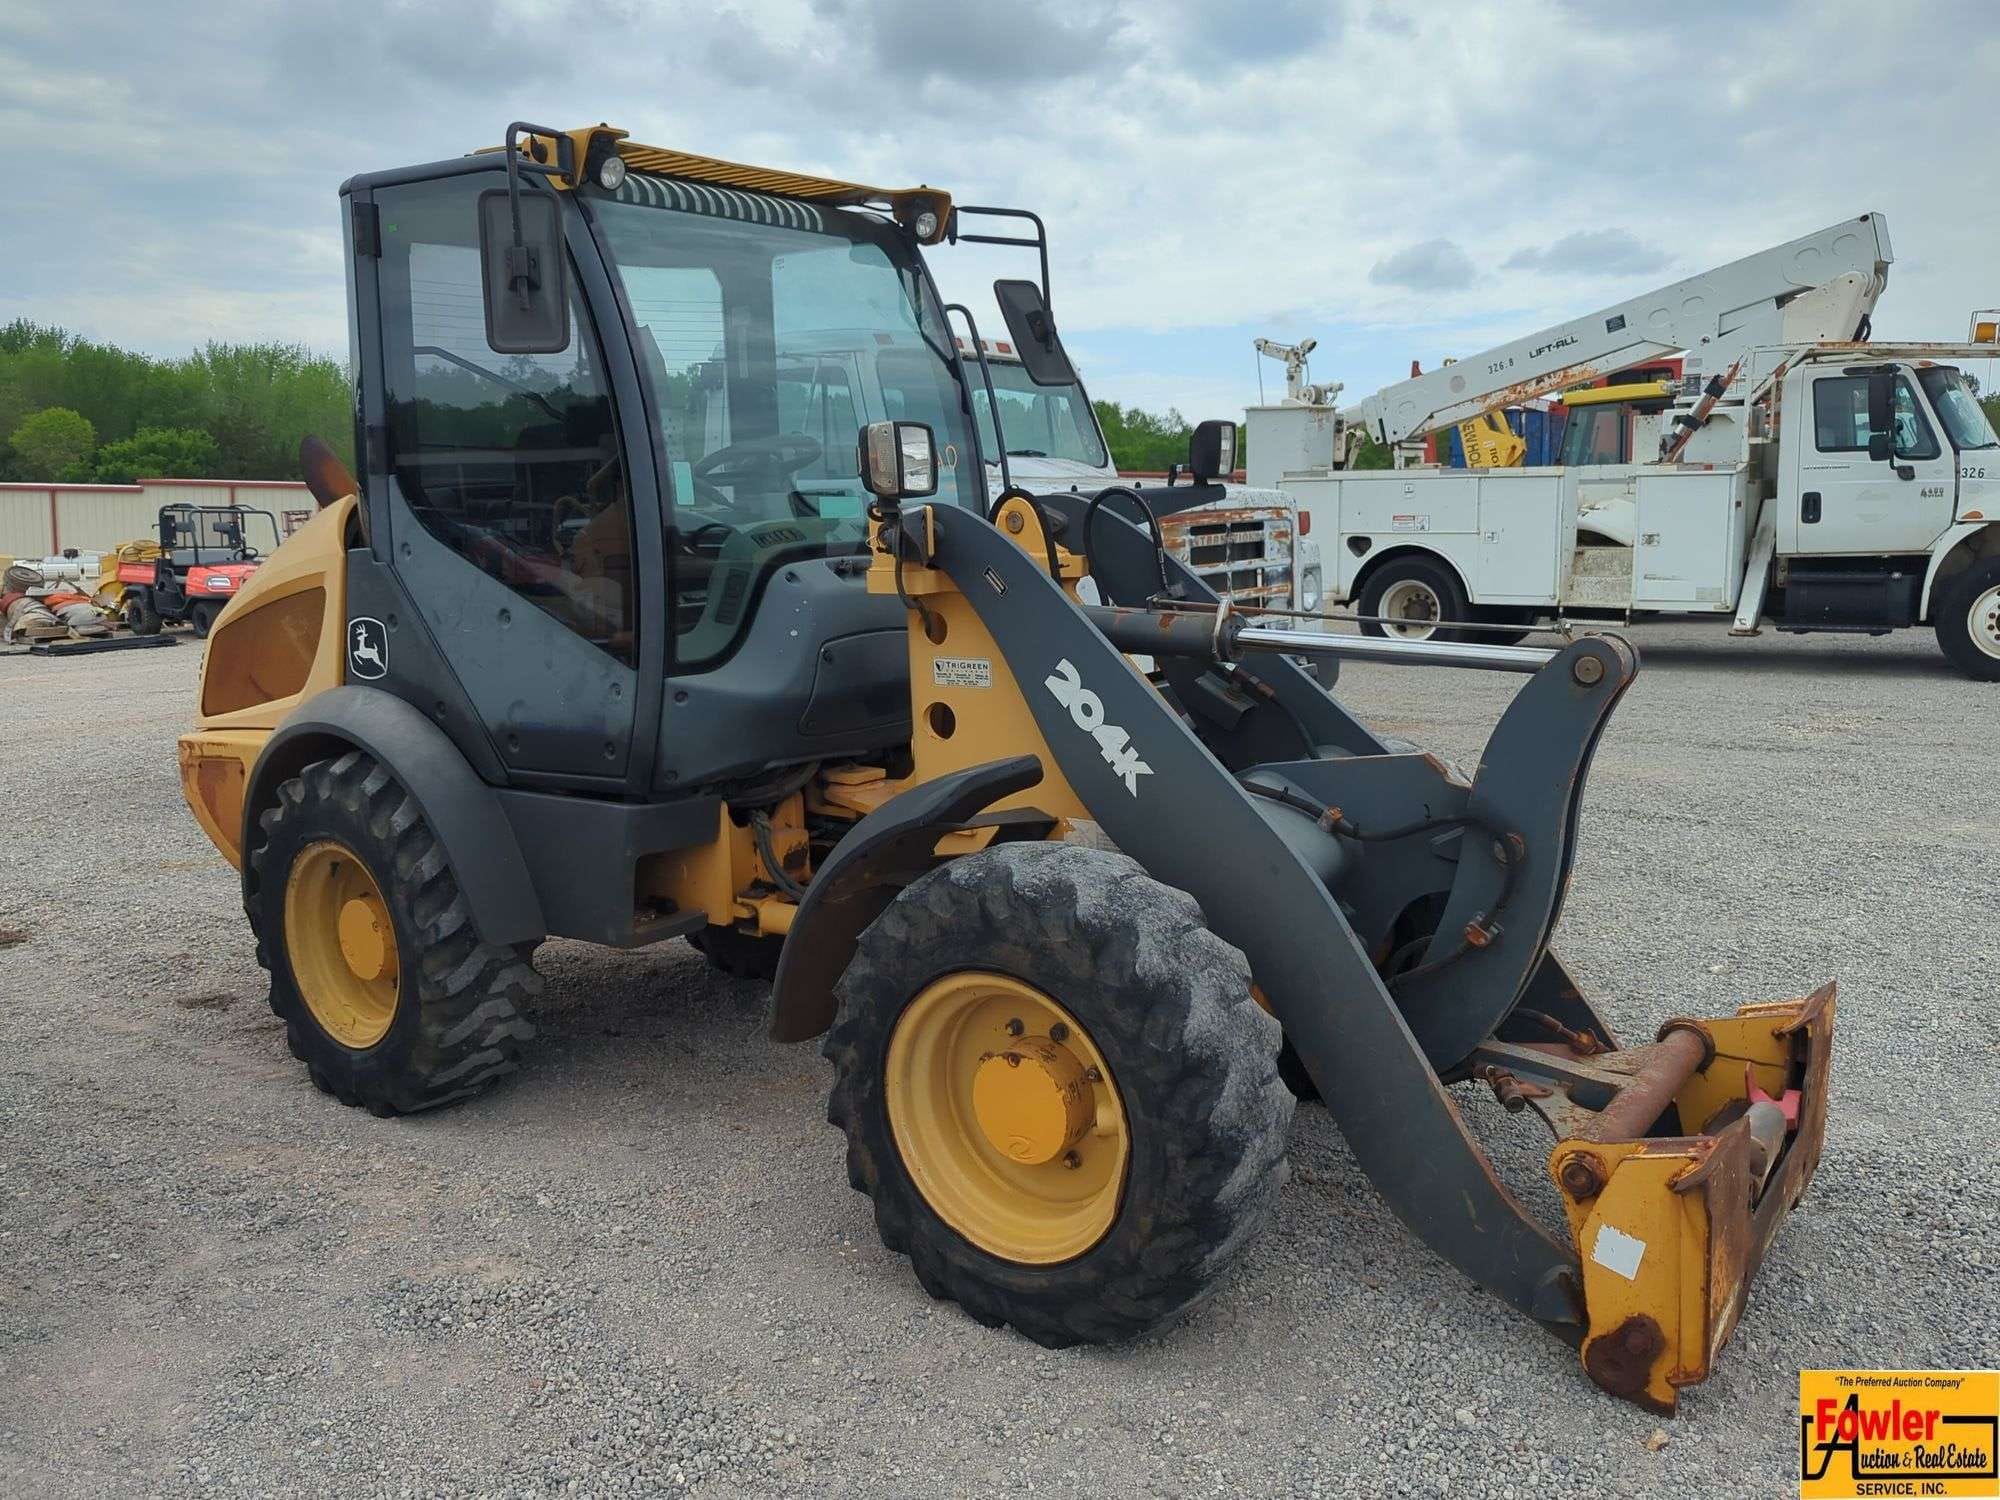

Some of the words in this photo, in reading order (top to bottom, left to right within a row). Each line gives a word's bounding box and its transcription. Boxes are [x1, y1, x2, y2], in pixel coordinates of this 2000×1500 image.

[1528, 336, 1579, 359] LIFT-ALL
[1961, 467, 1985, 479] 326
[1044, 658, 1155, 798] 204K
